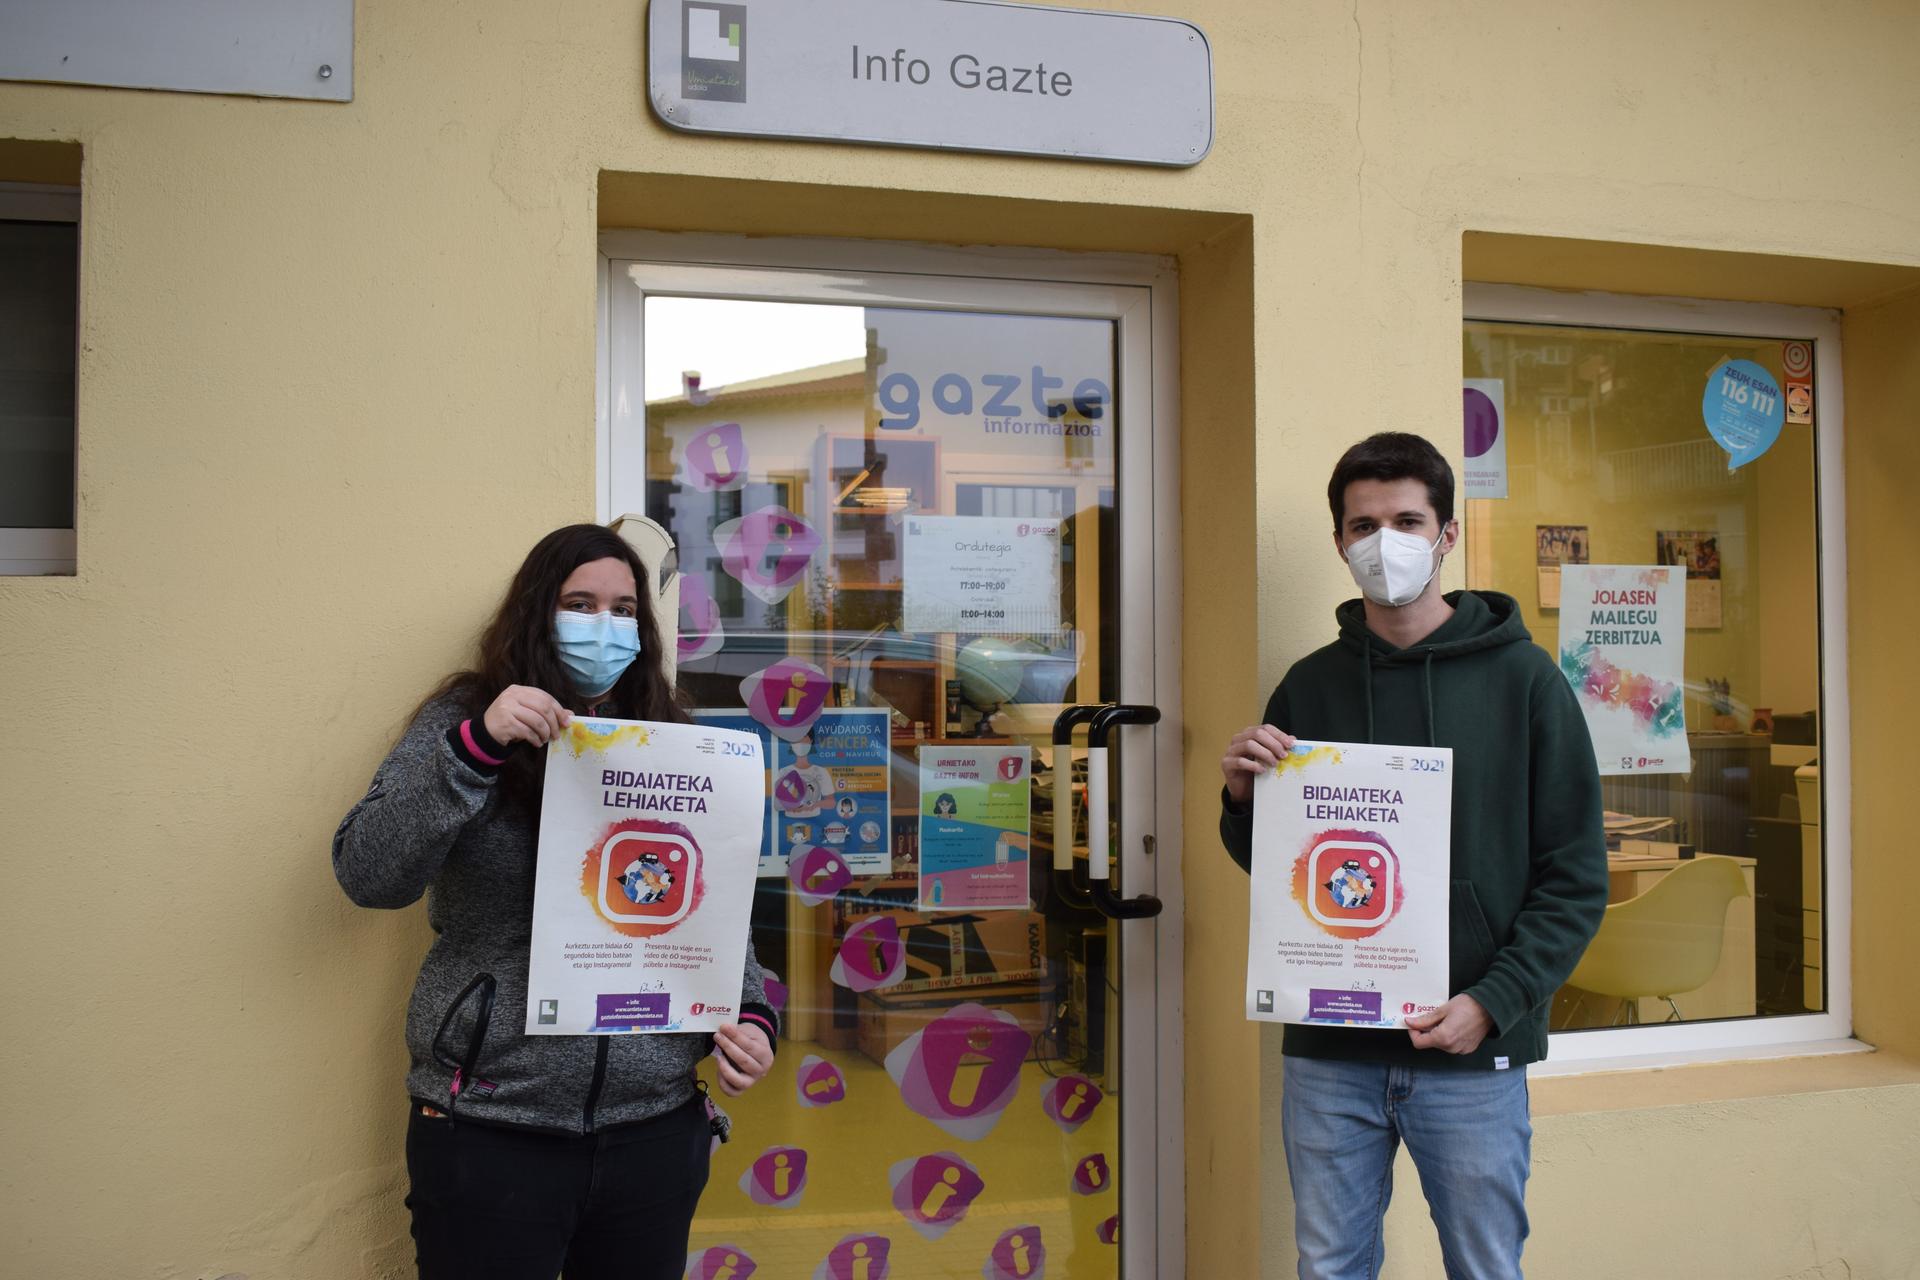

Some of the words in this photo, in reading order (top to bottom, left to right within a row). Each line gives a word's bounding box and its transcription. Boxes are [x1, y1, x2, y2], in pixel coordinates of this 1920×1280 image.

[852, 45, 931, 86] Info
[950, 54, 1073, 97] Gazte
[1725, 366, 1751, 385] ZEUK
[1751, 379, 1777, 397] ESAN
[879, 366, 1111, 430] gazte
[1721, 377, 1748, 404] 116
[1752, 391, 1775, 416] 111
[984, 418, 1102, 438] informazioa
[955, 540, 1011, 557] Ordutegia
[1592, 590, 1656, 605] JOLASEN
[1590, 610, 1657, 625] MAILEGU
[1585, 630, 1662, 645] ZERBITZUA
[818, 723, 872, 734] AYÚDANOS
[874, 725, 880, 733] A
[818, 736, 868, 749] VENCER
[870, 740, 880, 749] AL
[601, 769, 713, 793] BIDAIATEKA
[603, 791, 707, 814] LEHIAKETA
[1303, 785, 1403, 805] BIDAIATEKA
[1306, 804, 1399, 823] LEHIAKETA
[645, 943, 671, 951] Presenta
[680, 954, 708, 962] segundos
[706, 1006, 731, 1014] gazte
